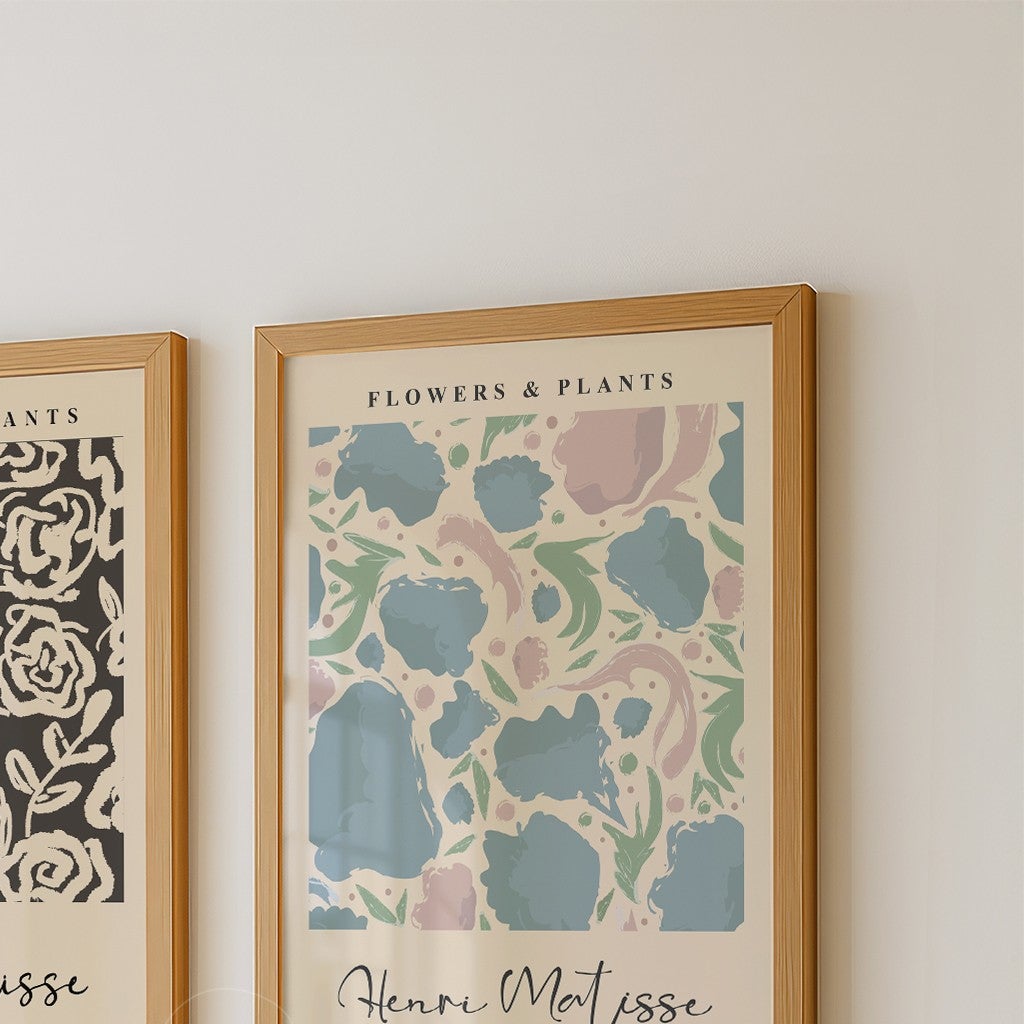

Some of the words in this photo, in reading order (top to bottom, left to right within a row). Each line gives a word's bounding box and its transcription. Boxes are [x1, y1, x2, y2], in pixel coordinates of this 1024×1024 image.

[367, 382, 505, 409] FLOWERS
[522, 380, 540, 399] &
[557, 372, 673, 397] PLANTS
[337, 964, 489, 1024] Henri
